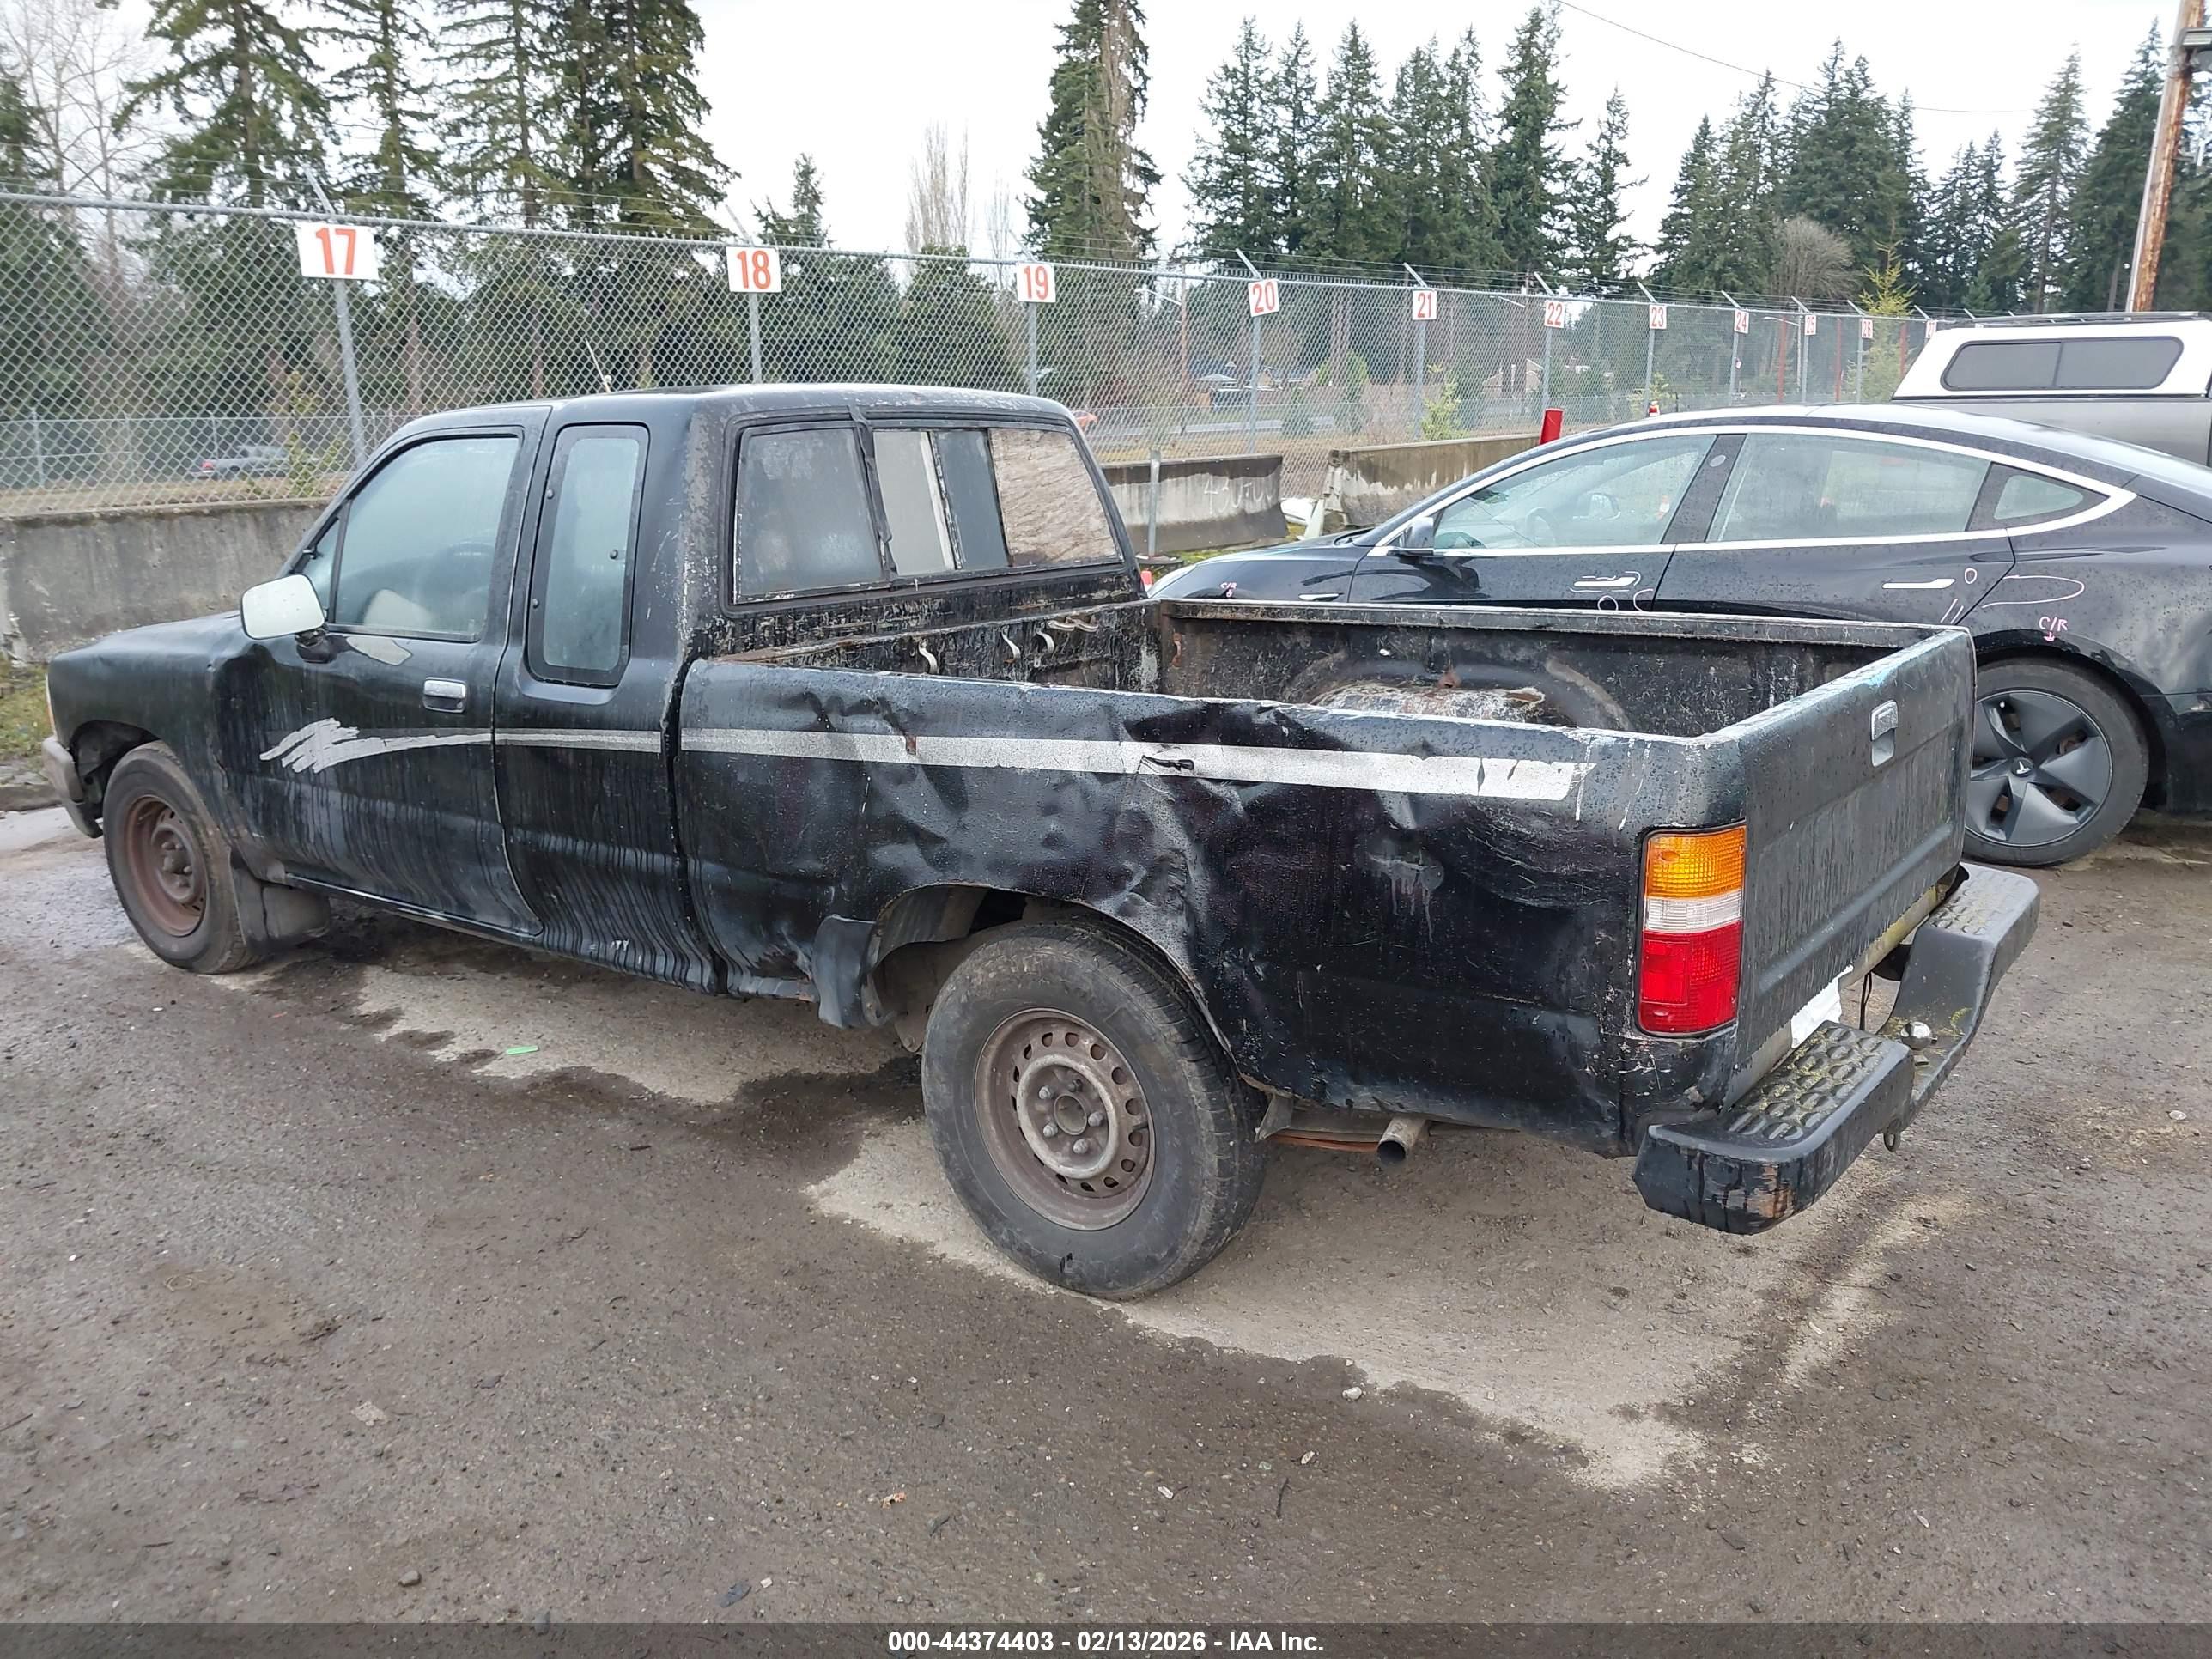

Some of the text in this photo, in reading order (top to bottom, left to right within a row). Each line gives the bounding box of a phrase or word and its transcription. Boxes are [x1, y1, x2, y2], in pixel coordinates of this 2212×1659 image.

[315, 227, 357, 275] 17
[737, 250, 771, 289] 18
[1023, 265, 1049, 300] 19
[1252, 283, 1275, 313] 20
[1417, 292, 1433, 319] 21
[1547, 303, 1561, 326] 22
[1651, 307, 1665, 328] 23
[1735, 312, 1747, 331] 24
[1806, 316, 1815, 333] 25
[1863, 321, 1872, 337] 26
[2039, 616, 2069, 632] C/R
